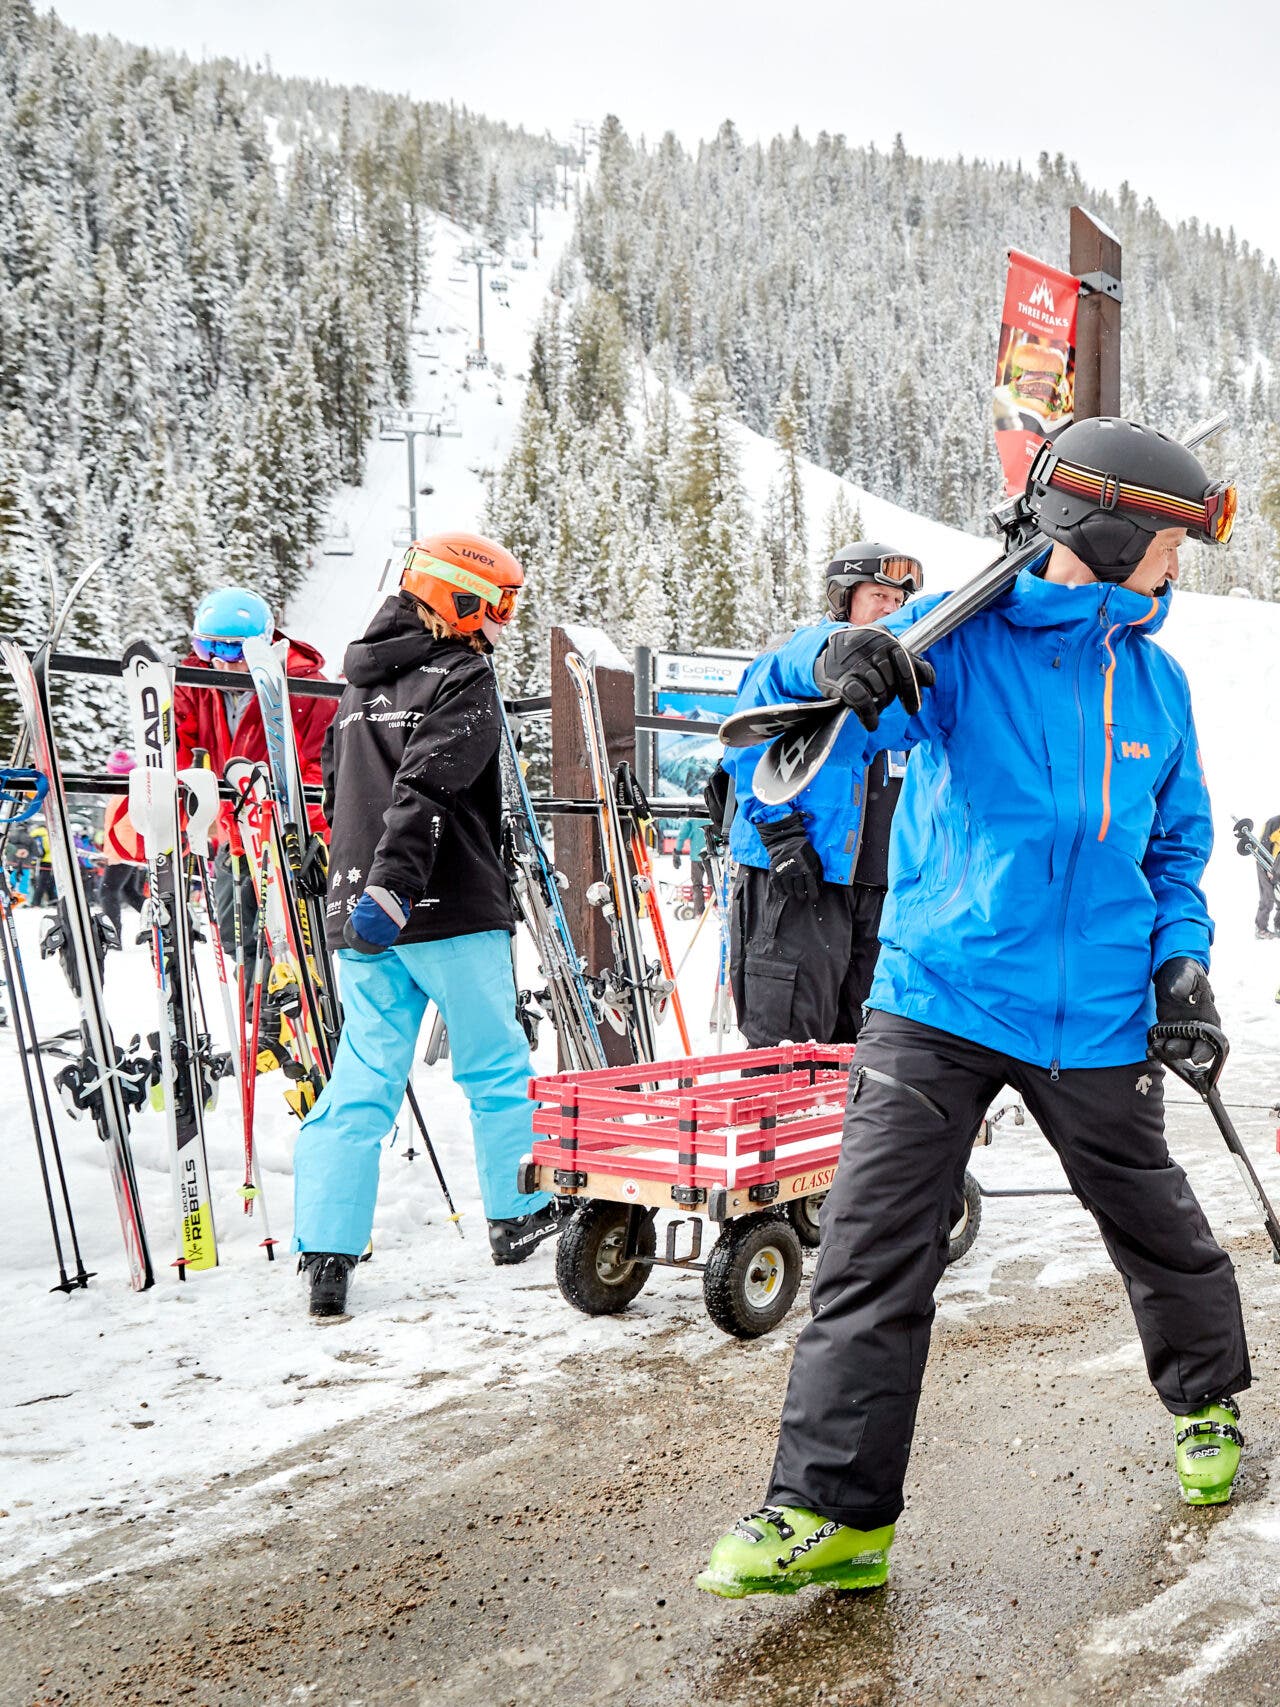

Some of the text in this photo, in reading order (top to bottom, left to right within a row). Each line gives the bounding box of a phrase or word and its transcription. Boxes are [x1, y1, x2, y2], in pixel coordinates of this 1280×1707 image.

[1018, 302, 1040, 320] THREE
[1041, 312, 1069, 328] PEAKS
[462, 548, 496, 568] uvex
[454, 571, 494, 597] uvex
[682, 665, 731, 676] GoPro
[141, 686, 163, 769] EAD
[366, 711, 424, 722] SUMMIT
[1122, 742, 1150, 759] HH
[297, 898, 312, 948] SCOTT
[792, 1168, 835, 1193] CLASSI
[181, 1183, 191, 1241] WORLDCUP
[185, 1159, 202, 1240] REBELS
[510, 1223, 558, 1250] HEAD
